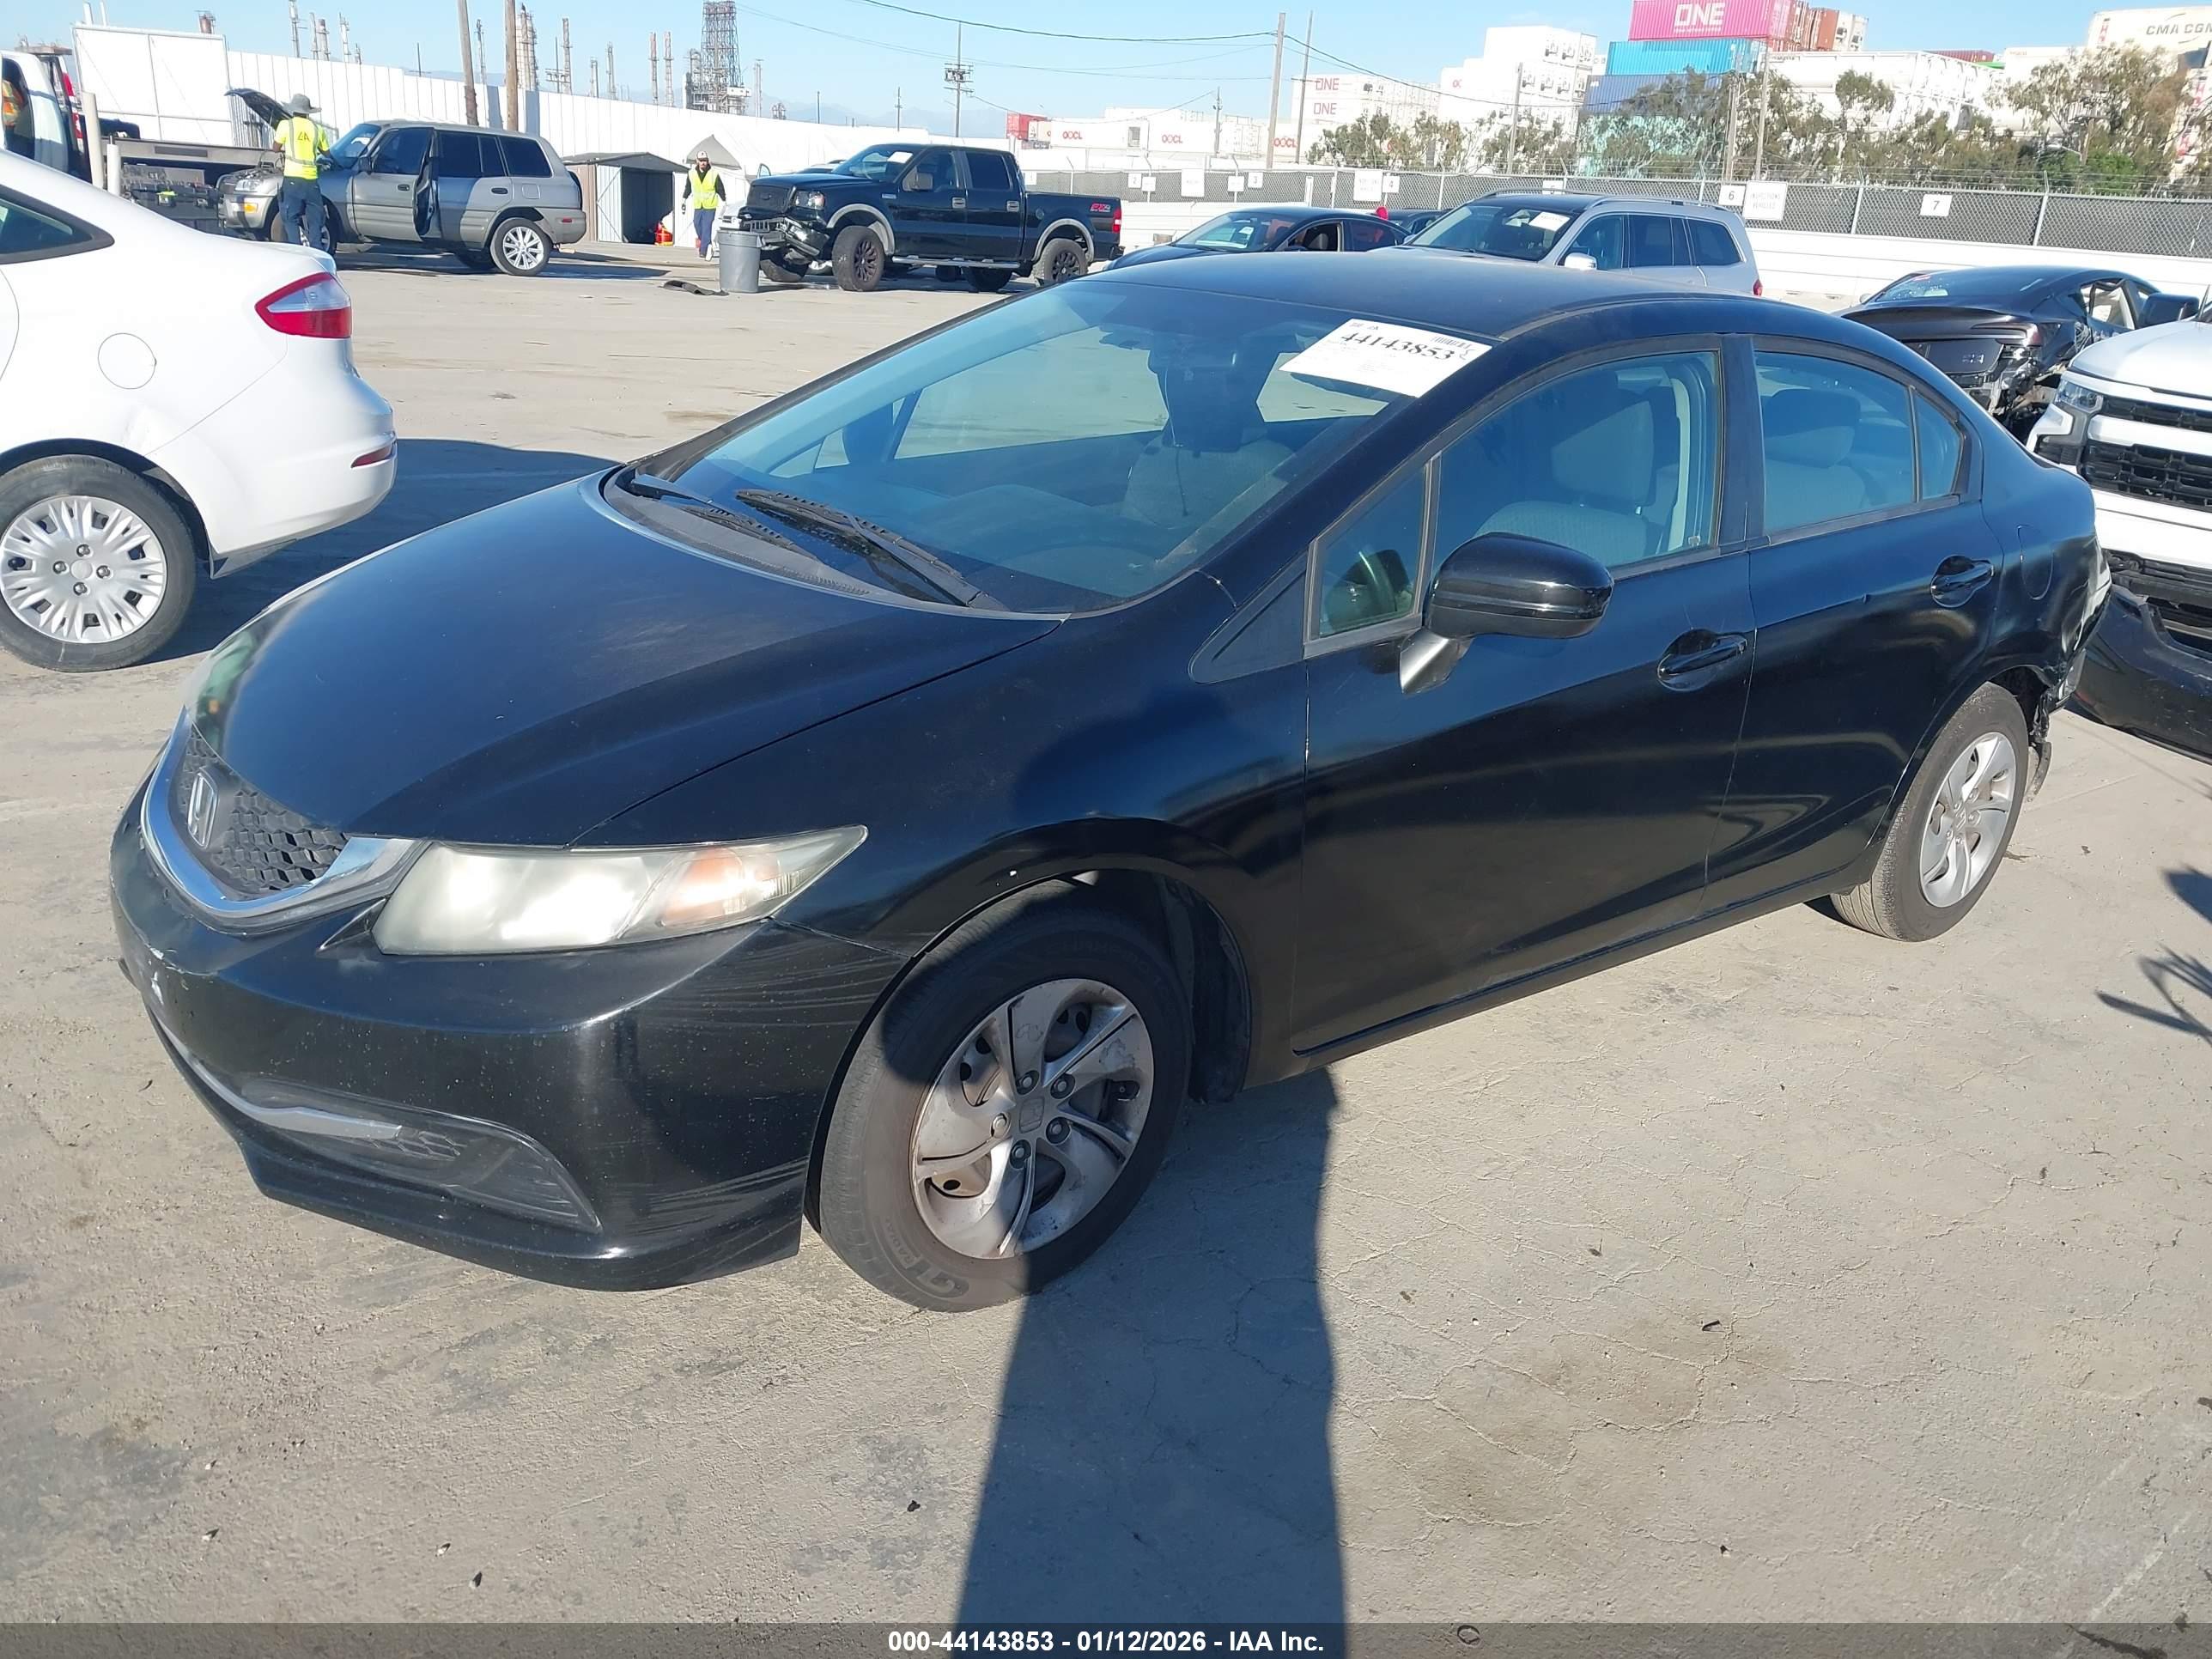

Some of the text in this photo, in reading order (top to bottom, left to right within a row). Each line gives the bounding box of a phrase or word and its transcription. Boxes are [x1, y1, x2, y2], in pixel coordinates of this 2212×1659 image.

[1674, 3, 1725, 27] ONE
[2146, 22, 2179, 35] CMA
[1316, 77, 1340, 91] ONE
[1313, 102, 1337, 115] ONE
[1062, 131, 1083, 140] OOCL
[1162, 134, 1183, 144] OOCL
[1273, 137, 1297, 148] OOCL
[1729, 190, 1735, 201] 6
[1933, 200, 1941, 211] 7
[1341, 331, 1455, 360] 44143853
